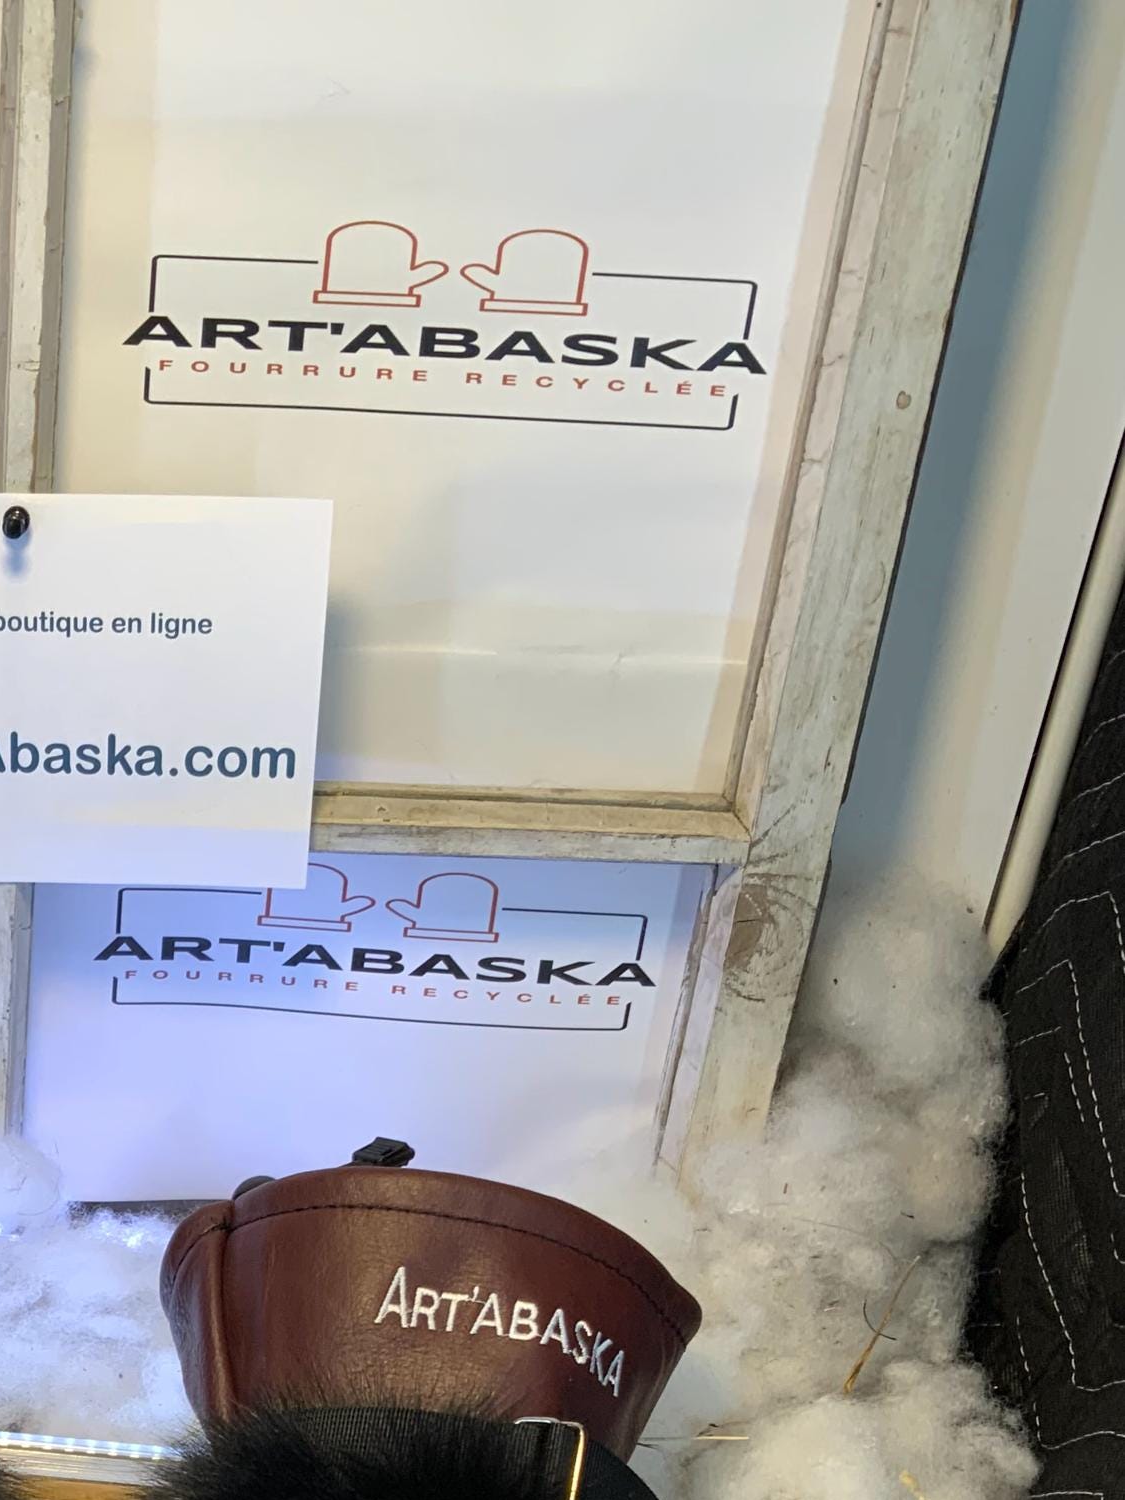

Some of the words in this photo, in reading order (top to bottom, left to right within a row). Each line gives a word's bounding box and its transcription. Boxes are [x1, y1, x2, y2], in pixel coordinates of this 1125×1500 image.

[122, 315, 767, 375] ART'ABASKA
[158, 358, 429, 383] FOURRURE
[465, 372, 728, 397] RECYCLÉE
[111, 617, 142, 633] en
[151, 612, 213, 639] ligne
[93, 935, 656, 987] ART'ABASKA
[125, 969, 359, 992] FOURRURE
[391, 985, 621, 1006] RECYCLÉE
[374, 1266, 624, 1398] ART'ABASKA
